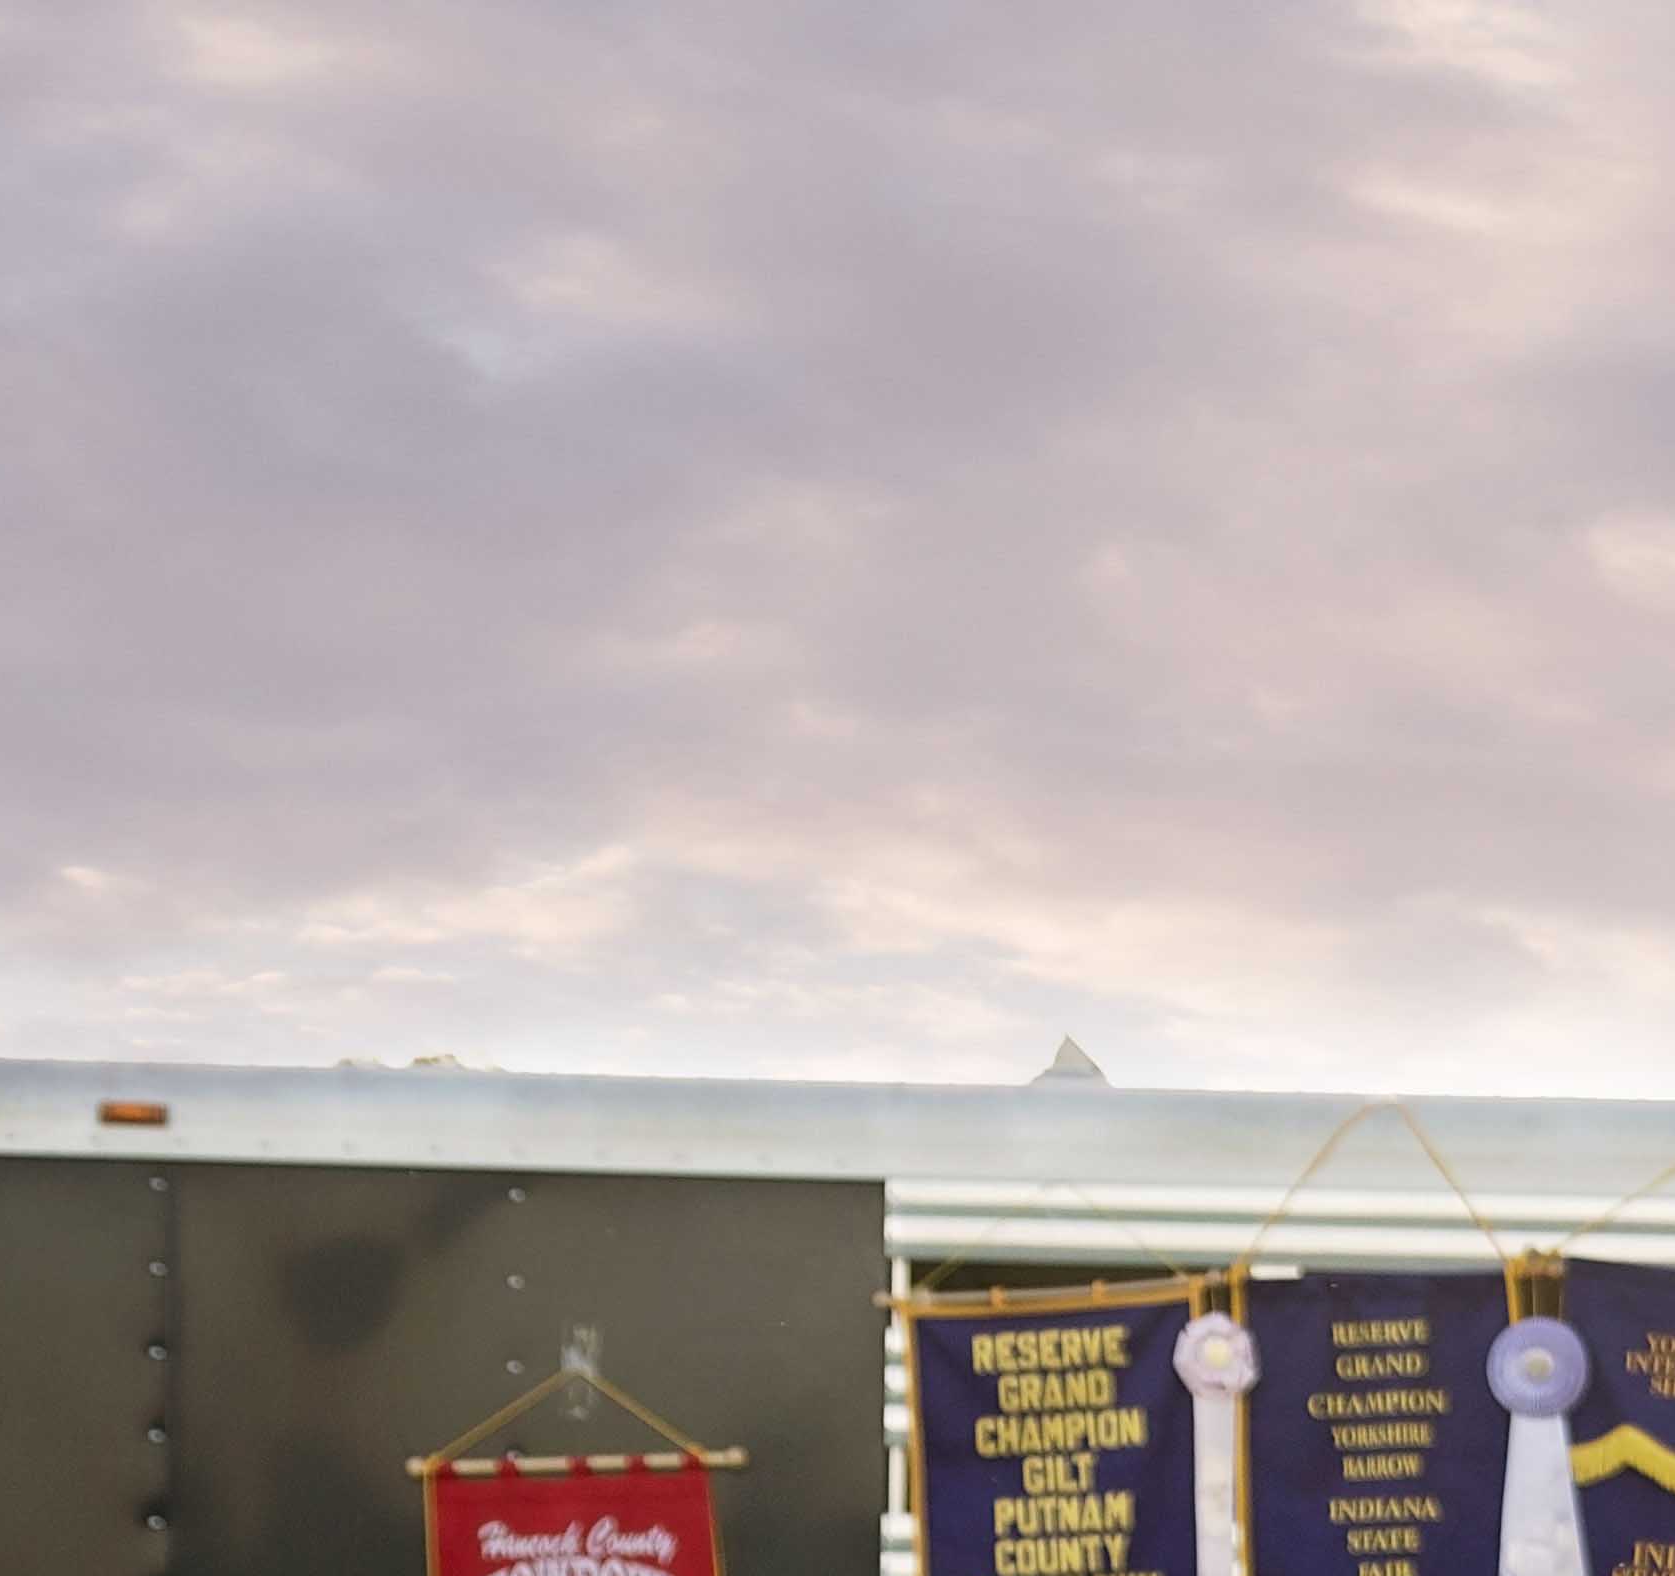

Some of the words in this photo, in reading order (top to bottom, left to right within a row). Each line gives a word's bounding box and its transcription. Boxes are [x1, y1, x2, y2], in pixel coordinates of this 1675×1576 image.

[1332, 1319, 1429, 1346] RESERVE
[972, 1325, 1130, 1374] RESERVE
[1335, 1351, 1423, 1380] GRAND
[997, 1368, 1117, 1413] GRAND
[1307, 1389, 1447, 1420] CHAMPION
[975, 1407, 1146, 1458] CHAMPION
[1331, 1422, 1434, 1449] YORKSHIRE
[1023, 1451, 1097, 1496] GILT
[1342, 1453, 1421, 1481] BARROW
[994, 1491, 1134, 1536] PUTNAM
[1328, 1497, 1439, 1523] INDIANA
[586, 1515, 678, 1564] County
[1347, 1528, 1419, 1554] STATE
